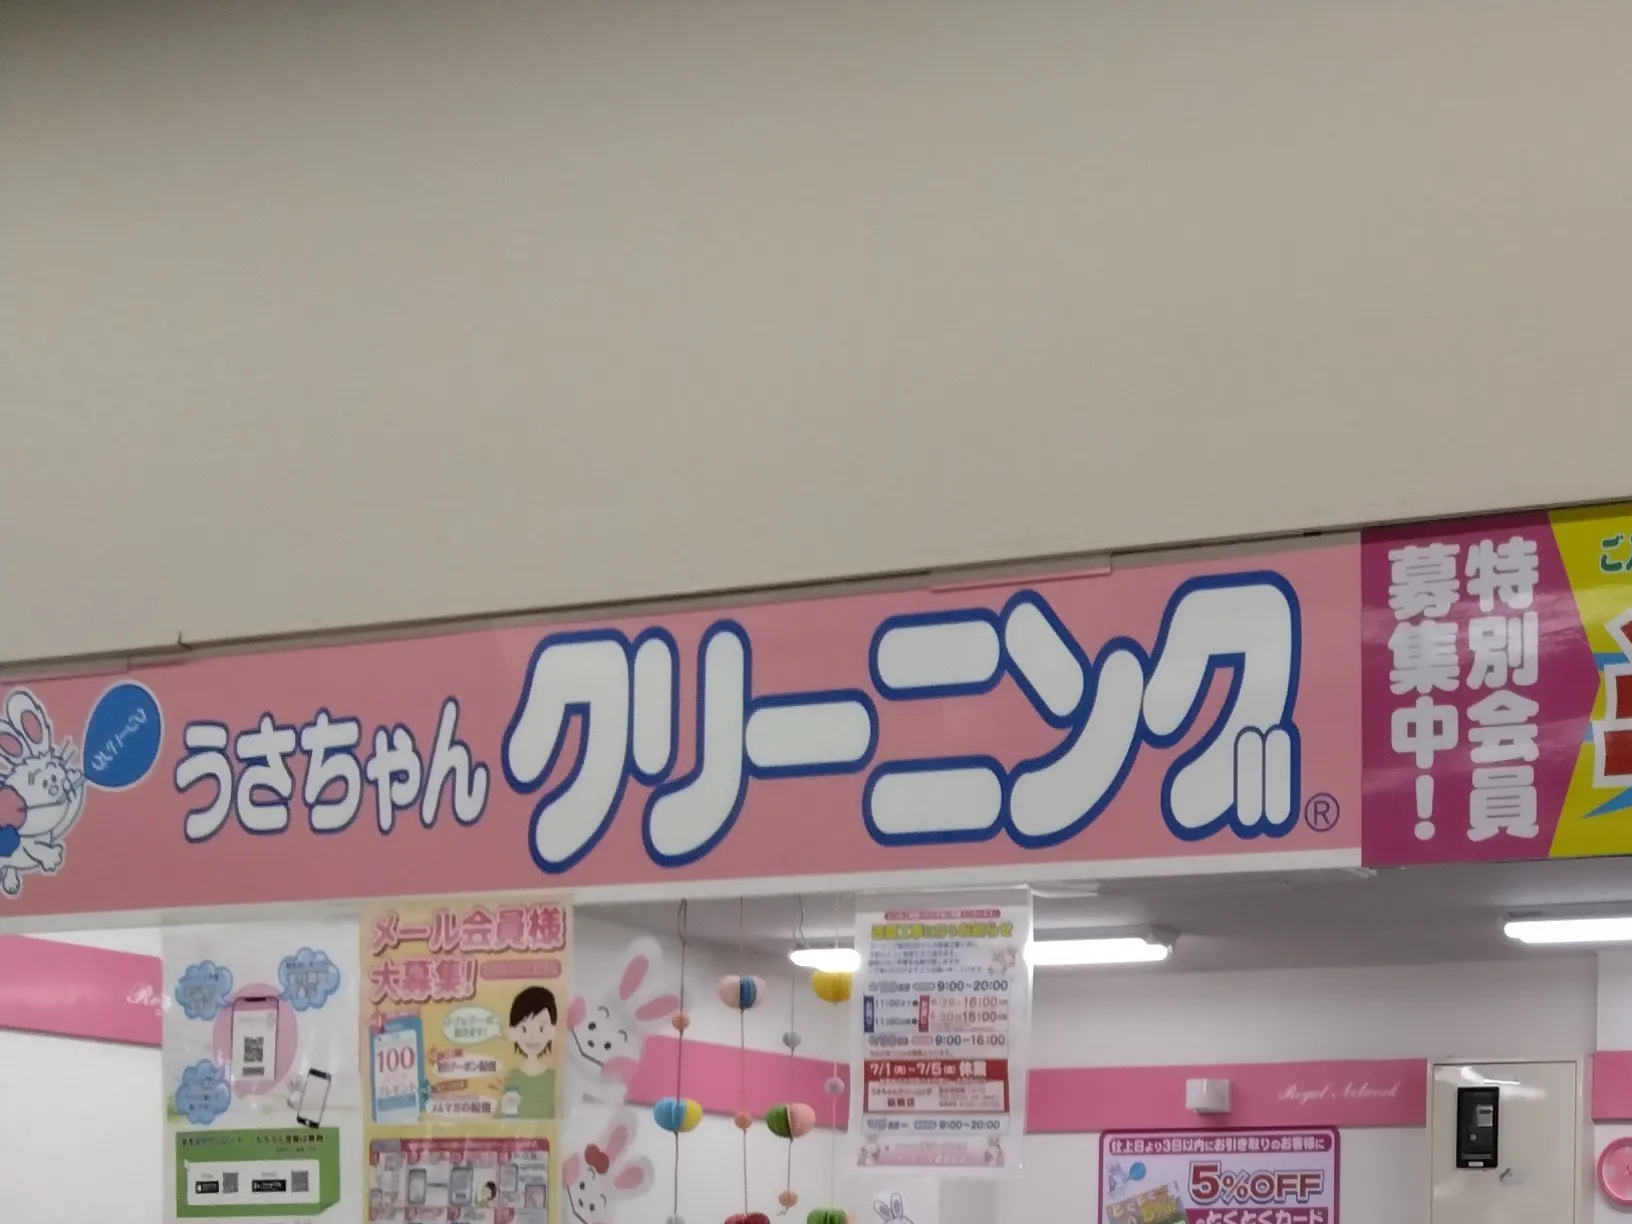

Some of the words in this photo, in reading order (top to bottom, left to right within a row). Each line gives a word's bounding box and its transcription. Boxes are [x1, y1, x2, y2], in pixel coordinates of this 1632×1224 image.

[174, 696, 488, 843] うさちゃん
[501, 569, 1301, 875] クリーニング
[1387, 542, 1458, 841] 募集中!
[1465, 538, 1541, 842] 特別会員
[371, 905, 565, 955] メール会員様
[1189, 1161, 1325, 1204] 5%OFF
